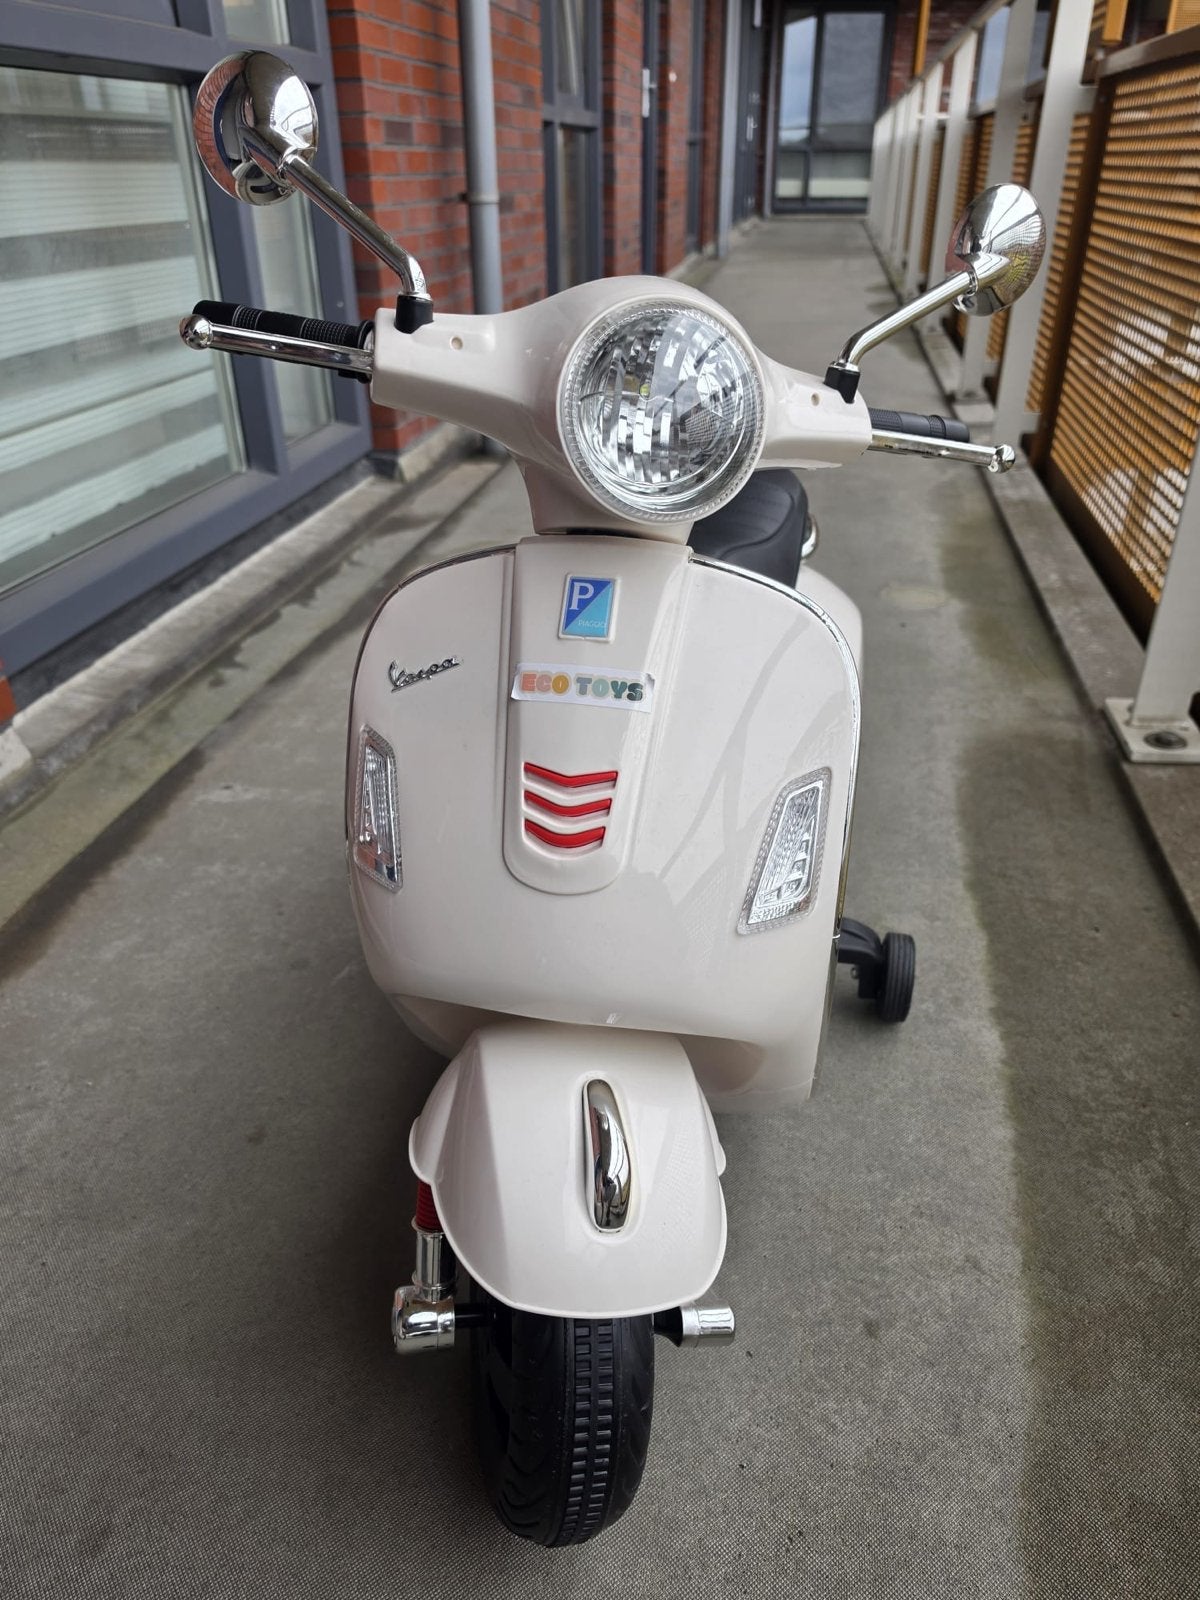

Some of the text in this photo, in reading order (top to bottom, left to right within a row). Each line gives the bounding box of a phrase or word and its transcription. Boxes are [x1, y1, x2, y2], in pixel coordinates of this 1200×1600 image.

[569, 581, 595, 611] P
[388, 658, 461, 693] Vespa
[521, 672, 645, 702] ECO TOYS
